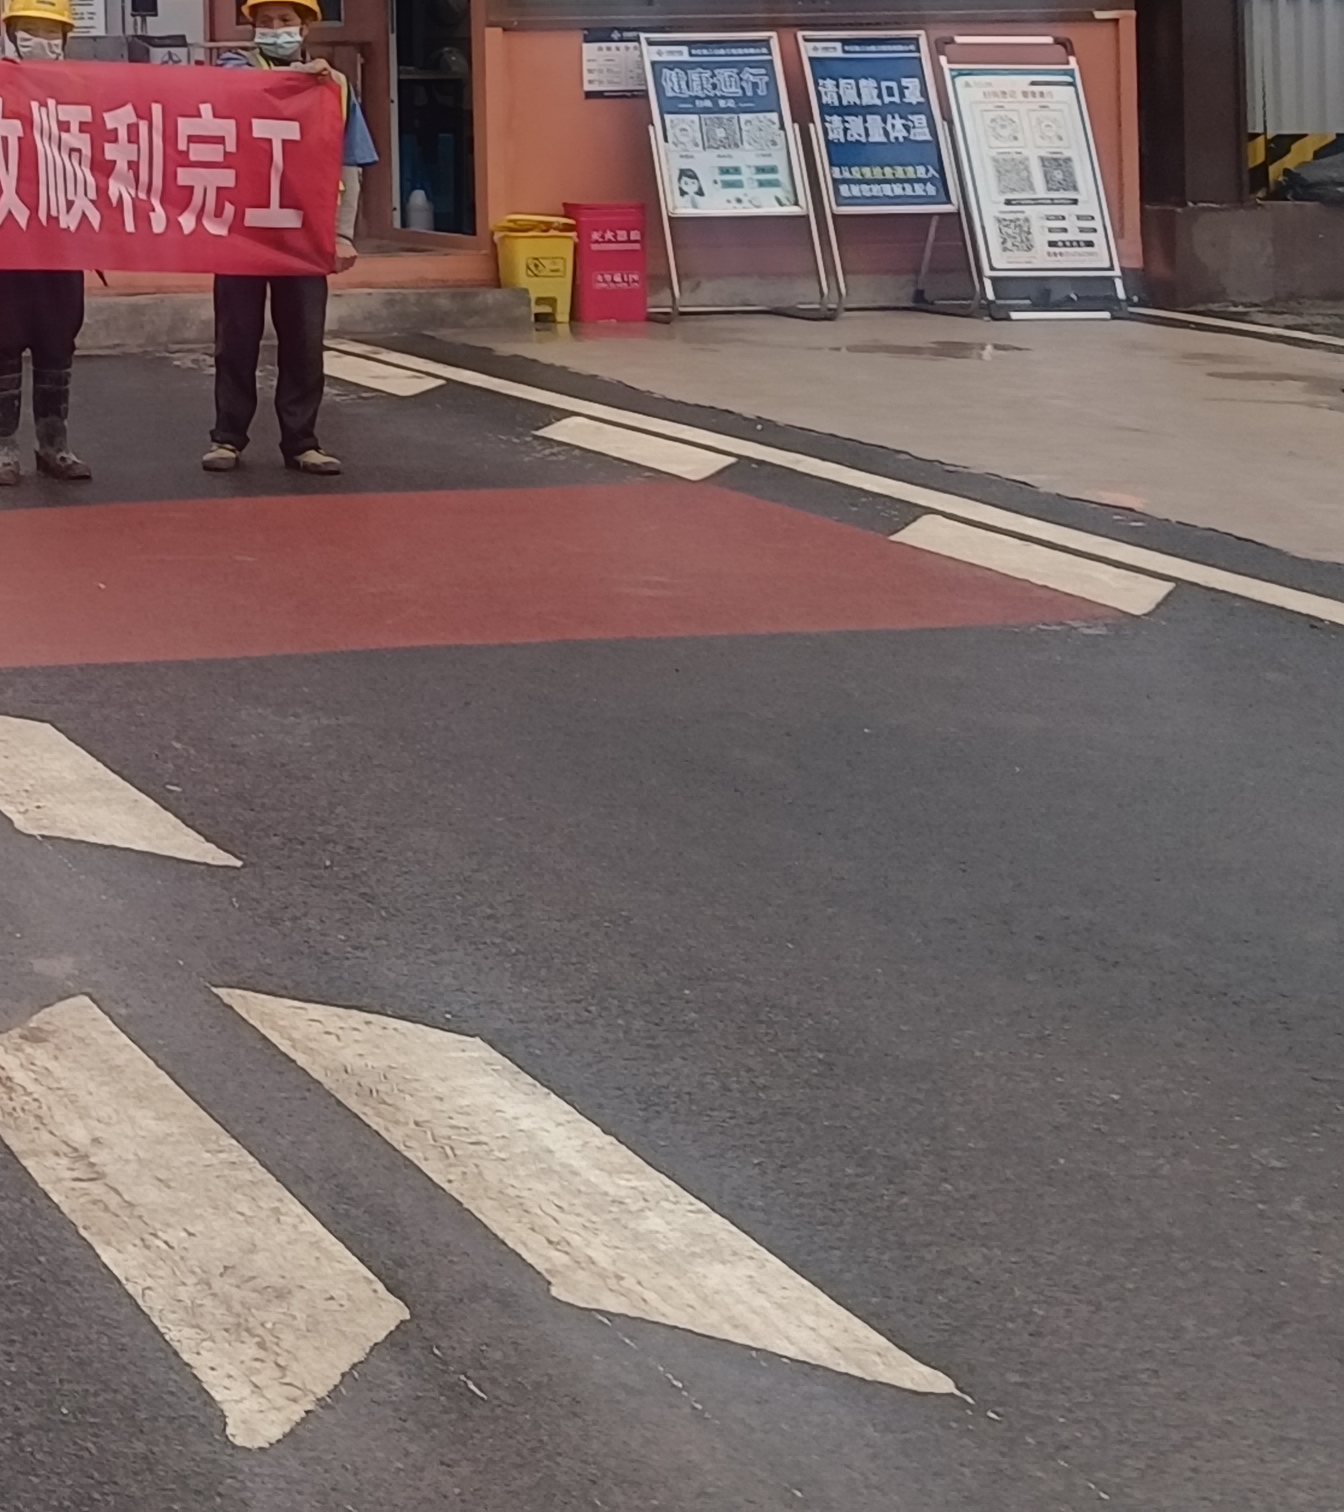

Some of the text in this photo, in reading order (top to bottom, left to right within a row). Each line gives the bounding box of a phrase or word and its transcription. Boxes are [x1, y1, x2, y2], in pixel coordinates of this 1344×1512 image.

[662, 67, 770, 97] 健康通行
[818, 77, 926, 106] 请佩戴口罩
[824, 113, 933, 142] 请测量体温
